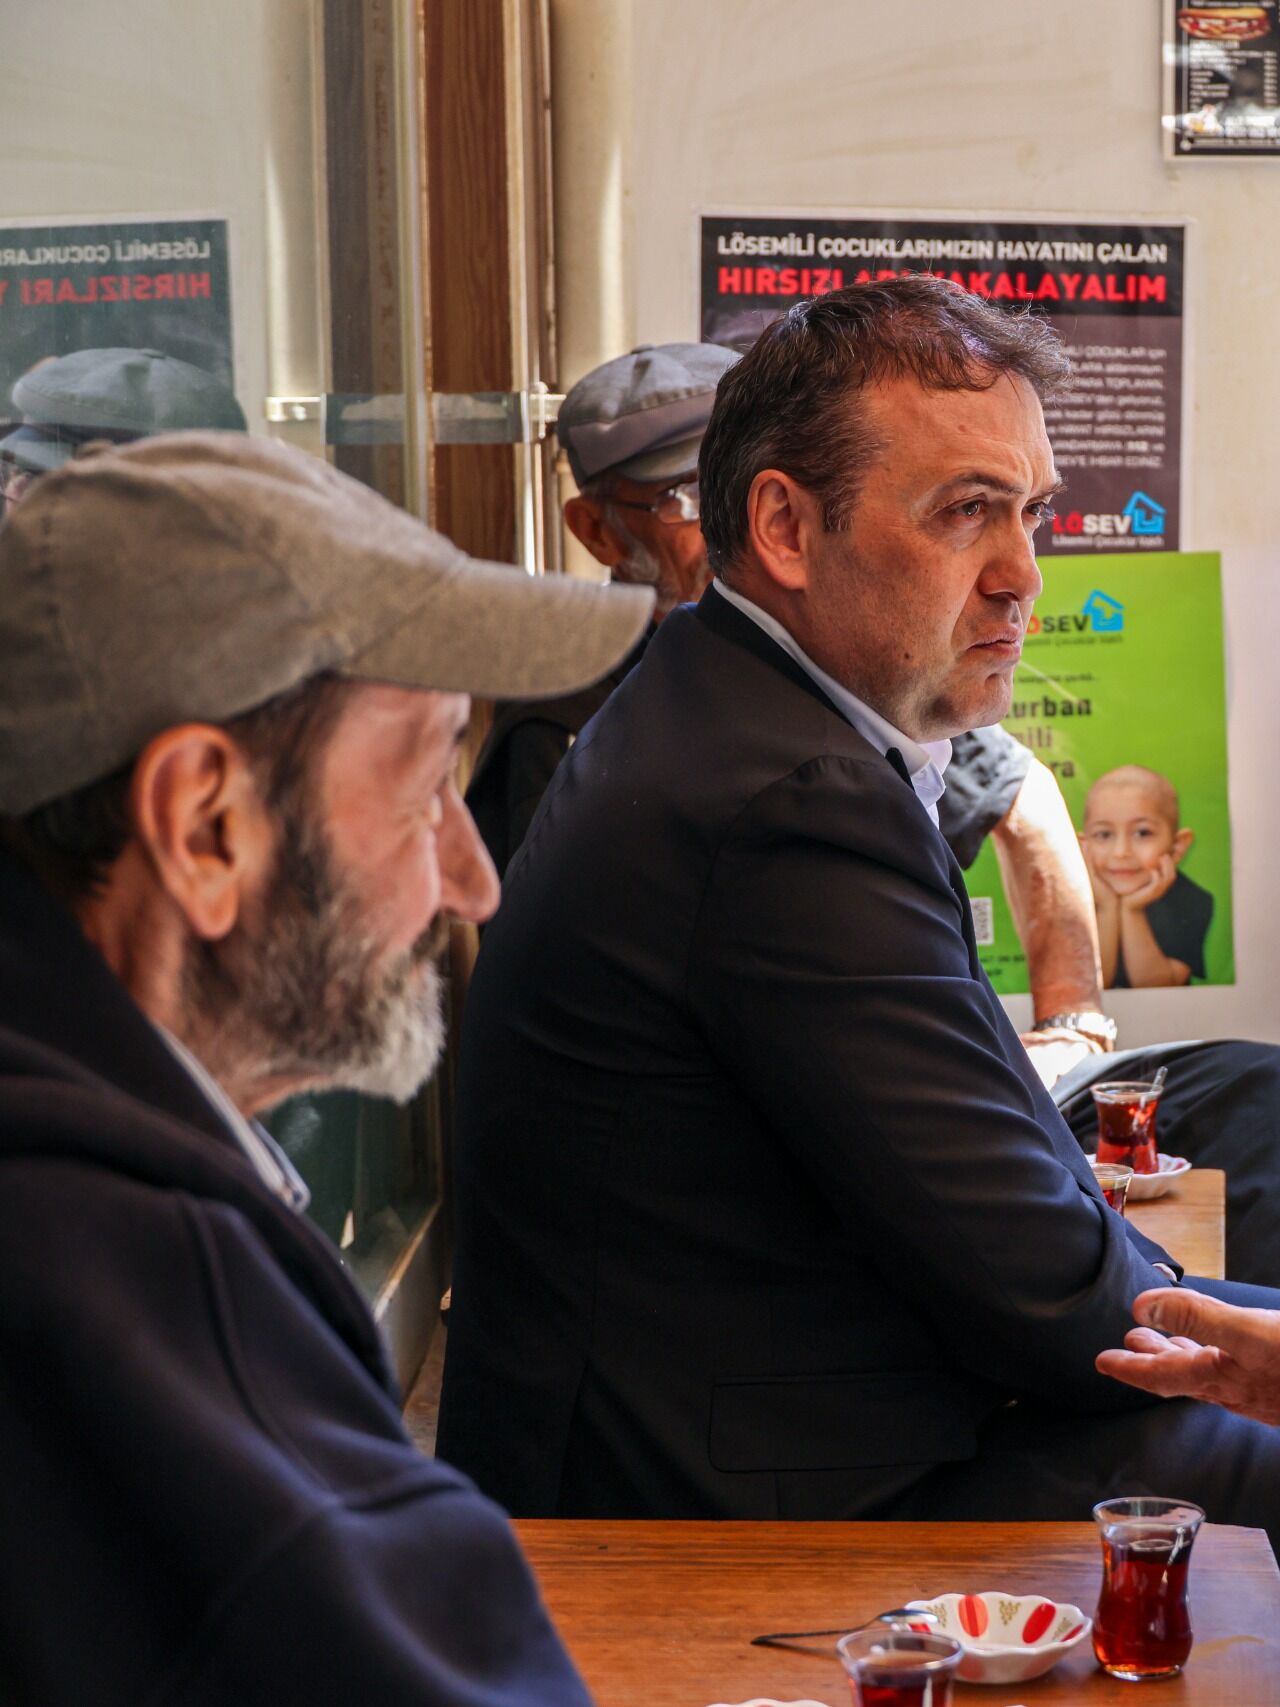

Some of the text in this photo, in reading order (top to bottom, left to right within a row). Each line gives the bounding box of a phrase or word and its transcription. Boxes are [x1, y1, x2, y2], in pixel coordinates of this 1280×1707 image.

[717, 232, 1168, 263] LÖSEMİLİ ÇOCUKLARIMIZIN HAYATINI ÇALAN
[717, 267, 1167, 303] HIRSIZL AKALAYALIM
[1005, 695, 1092, 719] urban
